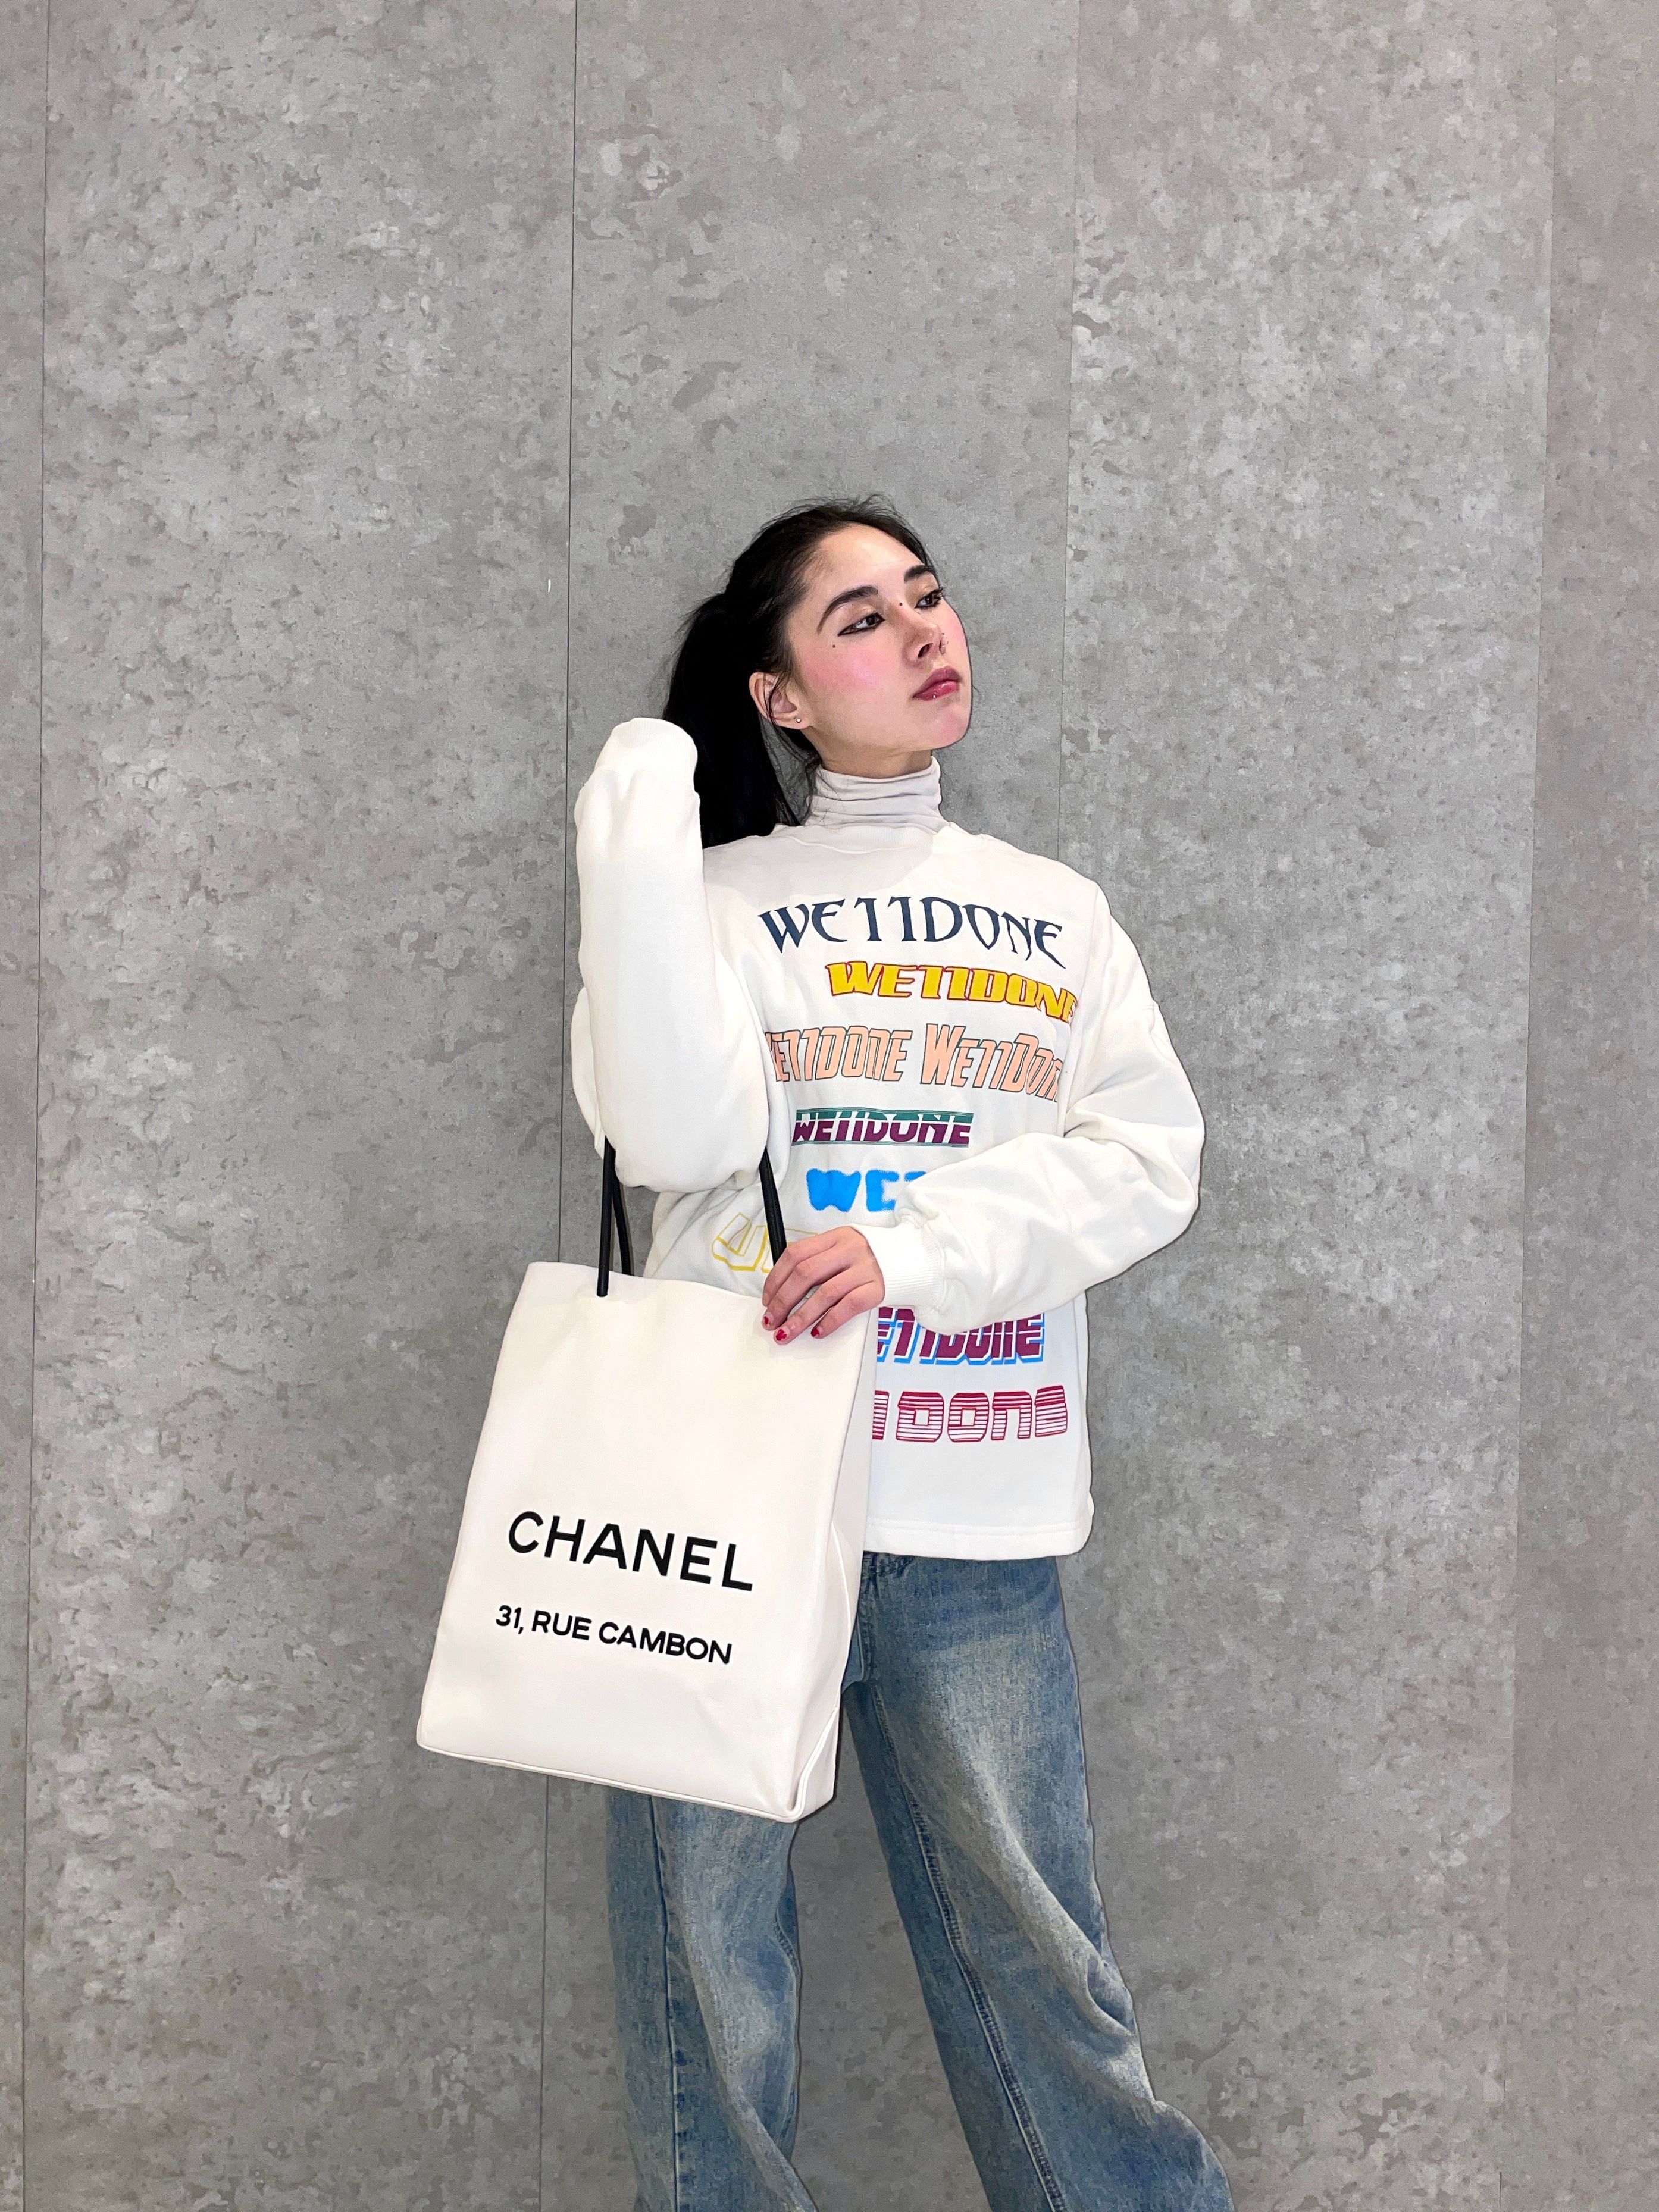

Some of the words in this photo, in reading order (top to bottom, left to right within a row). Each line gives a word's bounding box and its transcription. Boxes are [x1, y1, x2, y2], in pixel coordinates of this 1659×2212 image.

[508, 1511, 753, 1591] CHANEL
[495, 1605, 524, 1634] 31,
[531, 1610, 592, 1640] RUE
[599, 1622, 732, 1665] CAMBON
